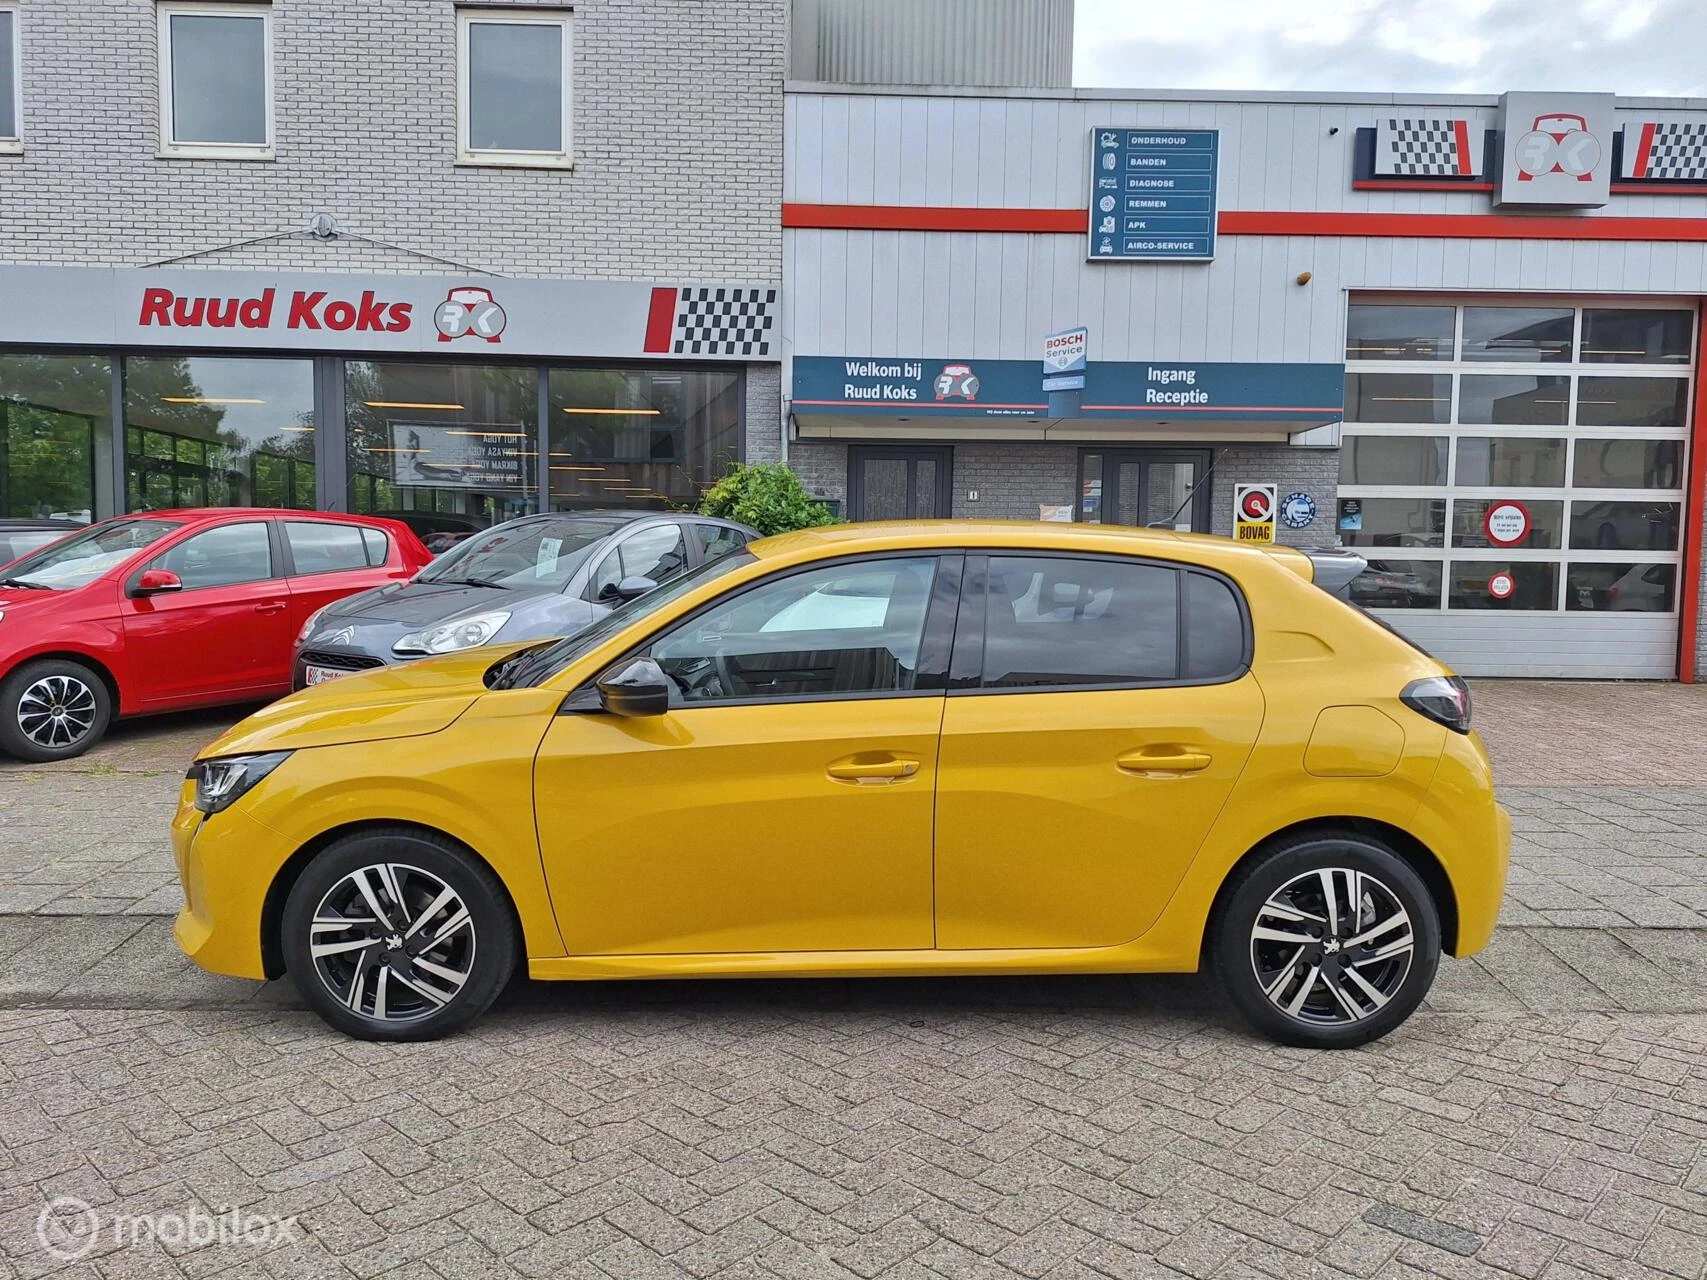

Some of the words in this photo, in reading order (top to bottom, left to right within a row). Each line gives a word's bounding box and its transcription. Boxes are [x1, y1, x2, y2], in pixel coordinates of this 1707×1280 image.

[1131, 136, 1187, 145] ONDERHOUD
[1130, 158, 1167, 166] BANDEN
[1129, 179, 1175, 188] DIAGNOSE
[1128, 200, 1167, 208] REMMEN
[1127, 221, 1147, 229] APK
[1127, 242, 1195, 250] AIRCO-SERVICE
[139, 287, 276, 329] Ruud
[287, 291, 413, 332] Koks
[1046, 334, 1083, 349] BOSCH
[1046, 346, 1083, 358] Service
[845, 361, 901, 377] Welkom
[904, 362, 922, 381] bij
[1147, 367, 1196, 385] Ingang
[844, 383, 880, 399] Ruud
[883, 385, 917, 400] Koks
[1146, 389, 1209, 406] Receptie
[1282, 494, 1315, 509] SCHADE
[1240, 526, 1270, 540] BOVAG
